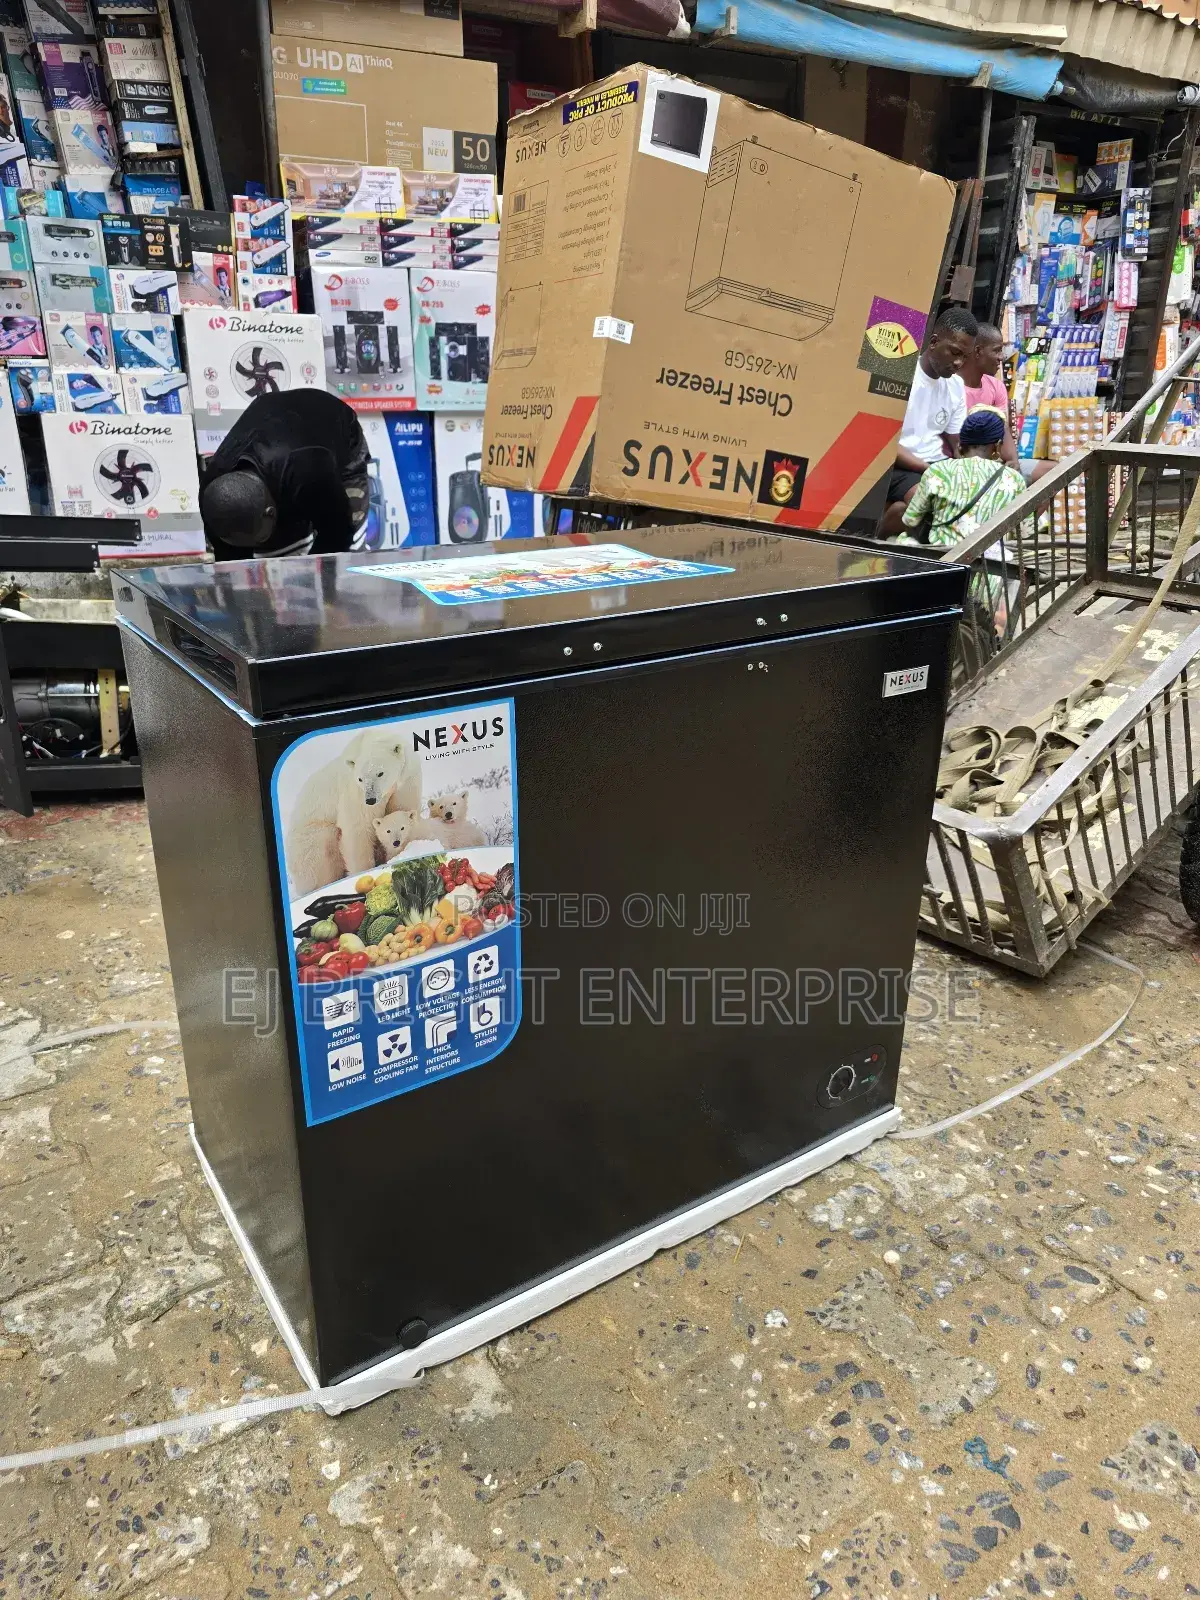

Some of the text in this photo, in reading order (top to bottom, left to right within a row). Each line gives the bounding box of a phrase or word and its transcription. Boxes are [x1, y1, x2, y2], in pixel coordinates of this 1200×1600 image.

[296, 46, 343, 71] UHD
[348, 54, 363, 71] AI
[365, 55, 393, 70] ThinQ
[569, 90, 635, 122] PRODUCT OF PRC
[428, 147, 448, 157] NEW
[461, 136, 490, 162] 50
[516, 139, 546, 163] NEXUS
[228, 317, 304, 335] Binatone
[878, 328, 896, 339] NAIJA
[268, 336, 286, 344] Simply
[874, 338, 894, 349] NEXUS
[725, 350, 798, 381] NX-265GB
[656, 367, 793, 418] Chest Freezer
[875, 380, 908, 396] FRONT
[500, 404, 553, 420] Chest Freezer
[91, 420, 172, 436] Binatone
[394, 422, 423, 432] AILIPU
[644, 420, 748, 448] LIVING WITH STYLE
[134, 438, 154, 446] Simply
[488, 444, 536, 468] NEXUS
[622, 440, 758, 496] NEXUS
[890, 671, 924, 688] NEXUS
[412, 716, 504, 752] NEXUS
[426, 743, 495, 761] LIVING WITH STYLE
[384, 989, 398, 998] LED
[462, 984, 507, 1004] CONSUMPTION
[464, 977, 504, 995] LESS ENERGY
[416, 992, 460, 1011] LOW VOLTAGE
[418, 1001, 459, 1019] PROTECTION
[378, 1008, 411, 1024] LED LIGHT
[332, 1026, 354, 1038] RAPID
[474, 1027, 498, 1040] STYLISH
[328, 1034, 361, 1048] FREEZING
[433, 1044, 452, 1054] THICK
[475, 1036, 497, 1048] DESIGN
[374, 1056, 418, 1076] COMPRESSOR
[425, 1057, 461, 1074] STRUCTURE
[426, 1050, 459, 1066] INTERIORS
[374, 1064, 419, 1084] COOLING FAN
[328, 1074, 366, 1092] LOW NOISE
